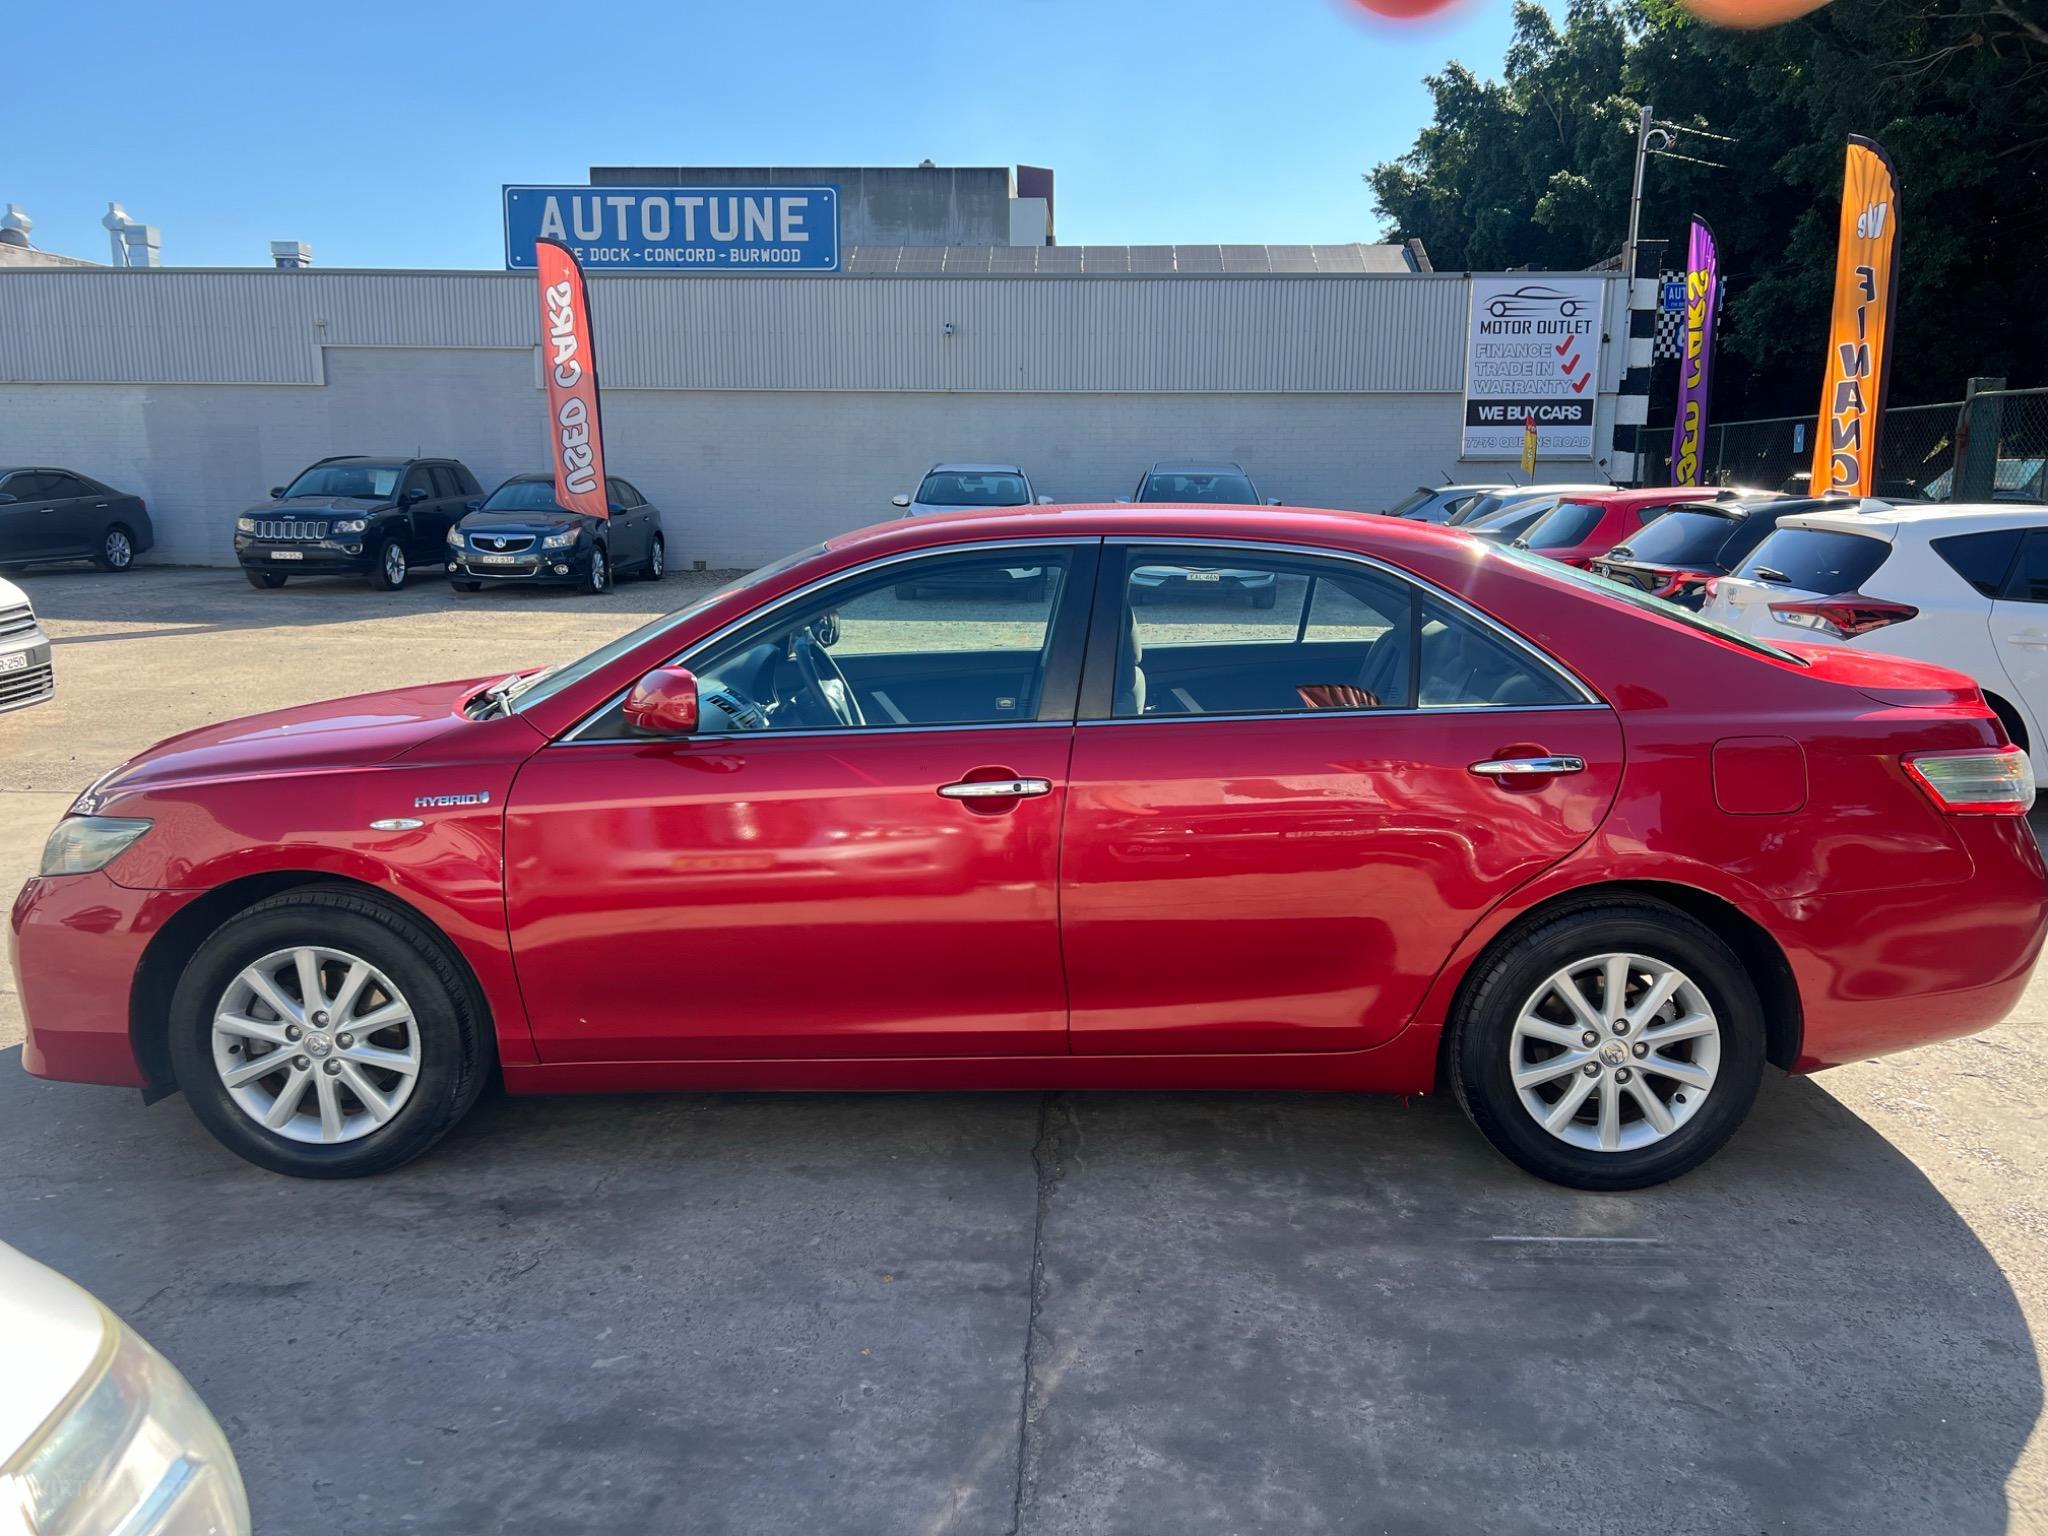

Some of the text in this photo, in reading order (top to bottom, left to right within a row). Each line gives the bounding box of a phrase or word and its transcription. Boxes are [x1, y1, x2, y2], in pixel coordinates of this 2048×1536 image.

[540, 196, 809, 242] AUTOTUNE
[590, 248, 630, 261] DOCK
[644, 248, 716, 262] CONCORD
[730, 248, 801, 262] BURWOOD
[1480, 320, 1593, 335] MOTOR OUTLET
[1475, 343, 1552, 359] FINANCE
[1475, 361, 1554, 376] TRADE IN
[1474, 380, 1573, 394] WARRANTY
[1478, 405, 1582, 420] WE BUY CARS
[1499, 437, 1551, 448] QUENS
[414, 794, 479, 808] HYBRID
